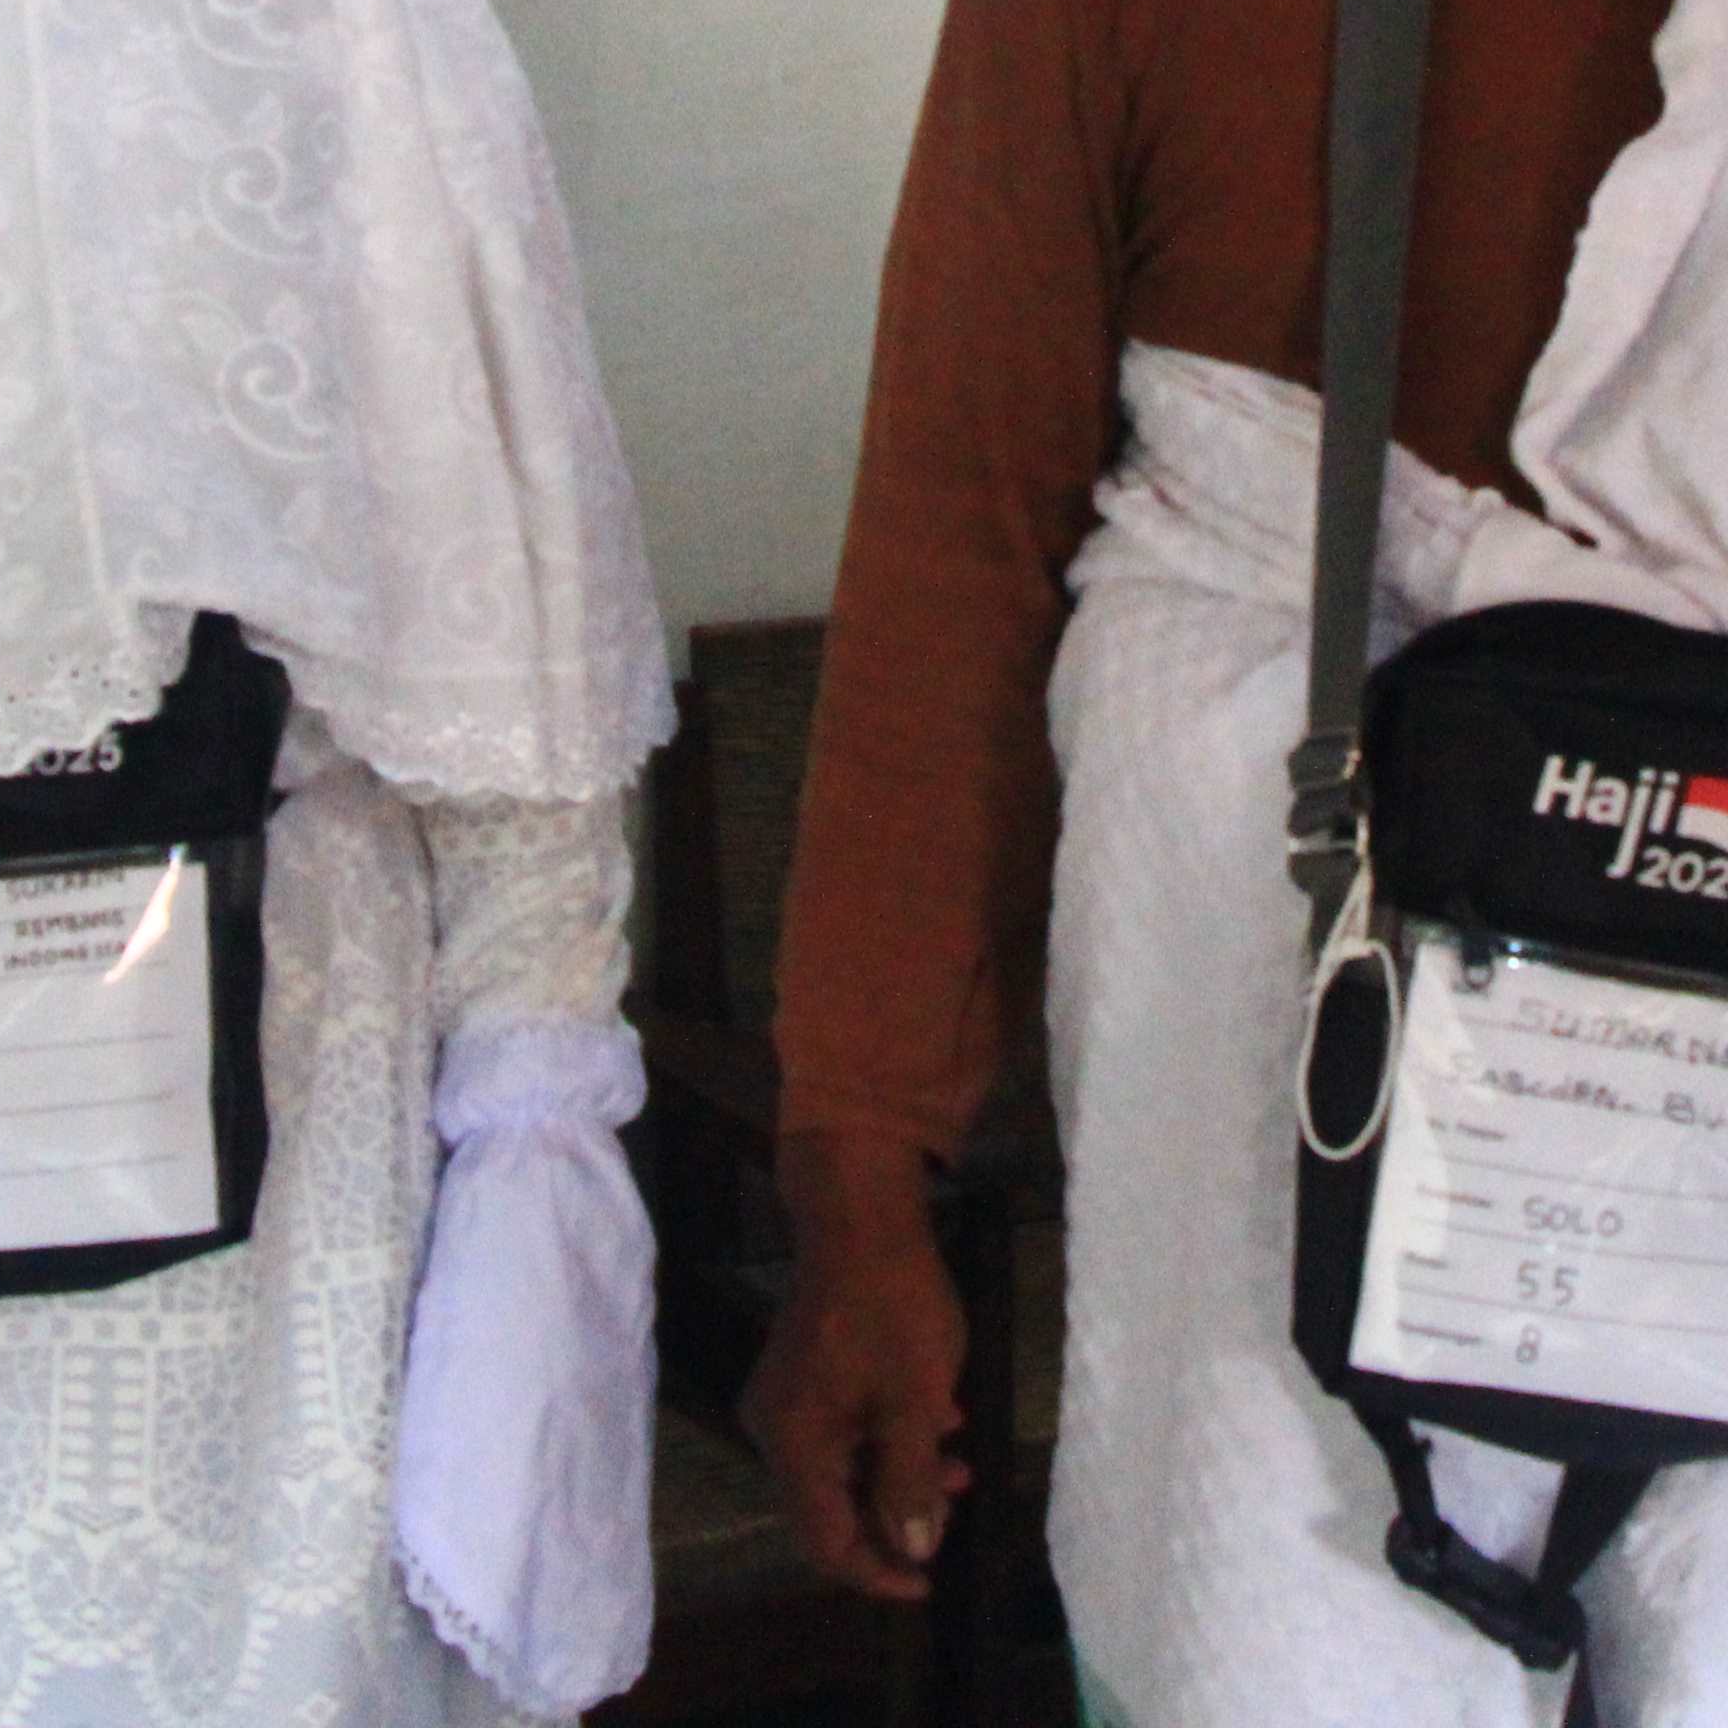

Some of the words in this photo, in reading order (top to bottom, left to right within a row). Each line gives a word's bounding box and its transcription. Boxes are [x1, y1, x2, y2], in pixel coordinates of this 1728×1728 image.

[29, 730, 123, 774] 025
[1532, 753, 1681, 879] Haji
[1523, 1195, 1623, 1238] SOLO
[1516, 1324, 1542, 1364] 8
